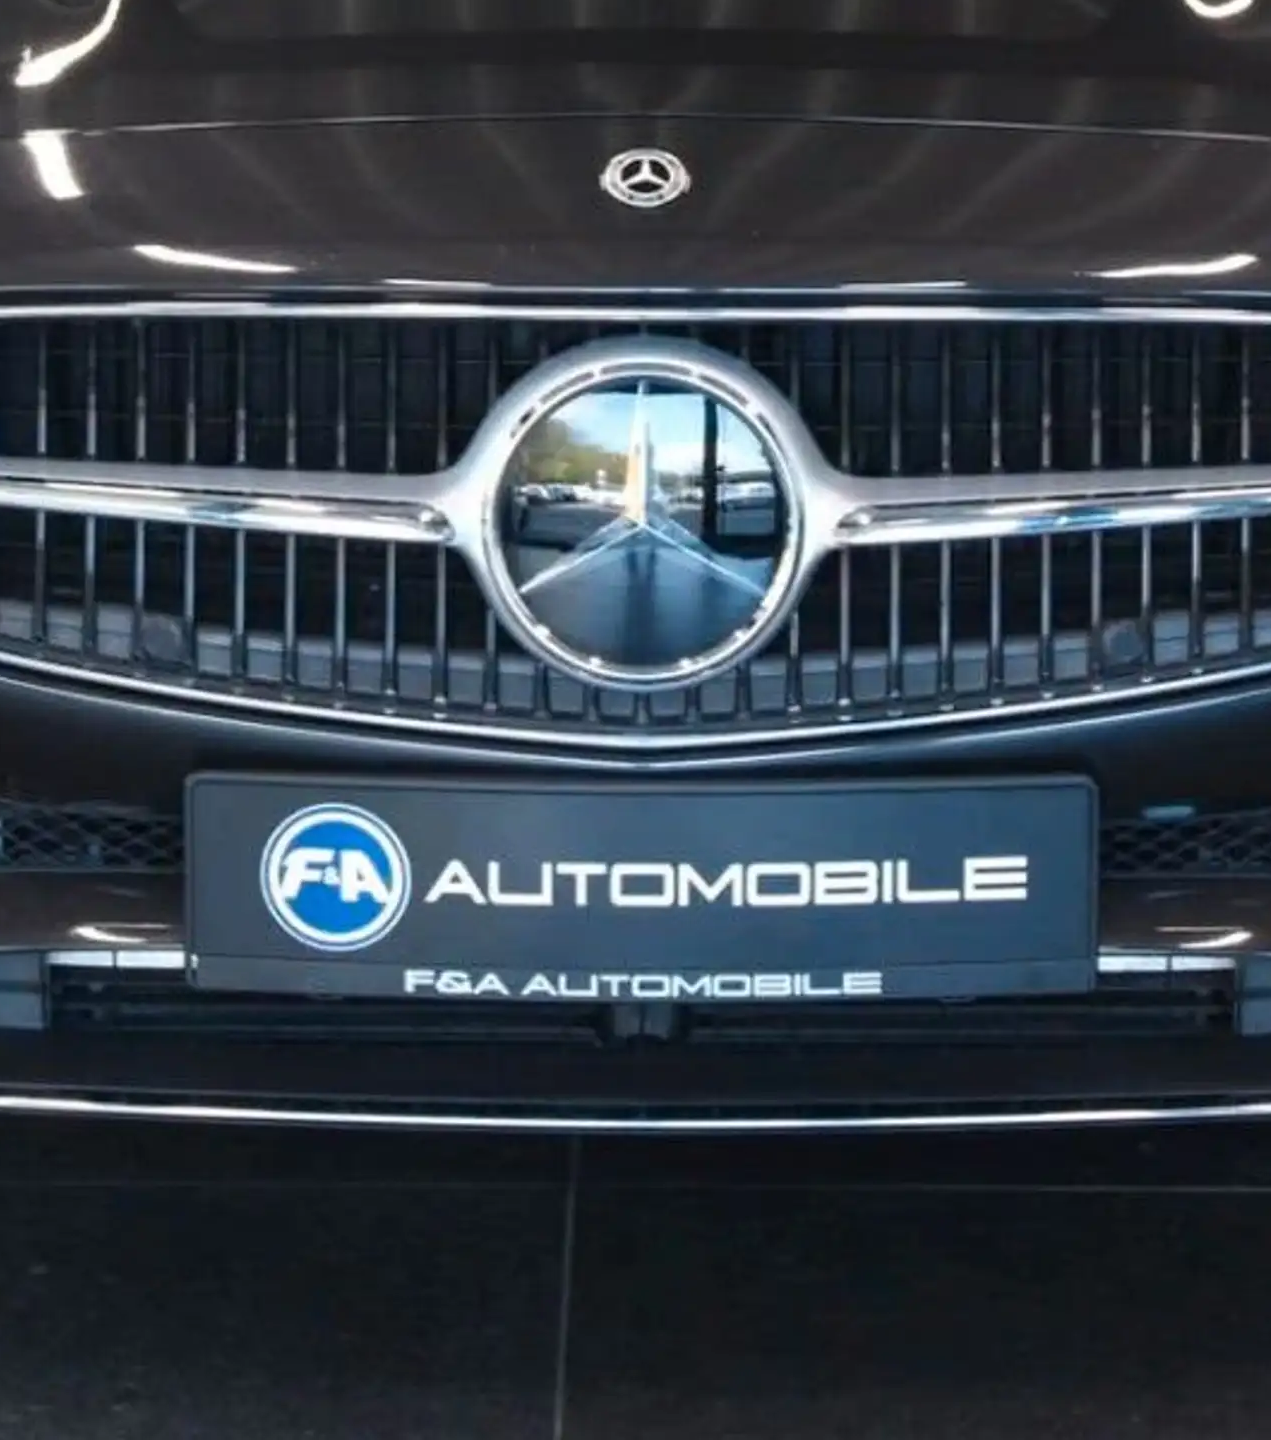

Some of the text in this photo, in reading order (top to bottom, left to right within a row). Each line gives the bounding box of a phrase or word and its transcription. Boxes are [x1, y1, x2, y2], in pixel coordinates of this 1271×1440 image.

[280, 846, 1029, 908] F&A AUTOMOBILE
[402, 968, 884, 999] F&A AUTOMOBILE
